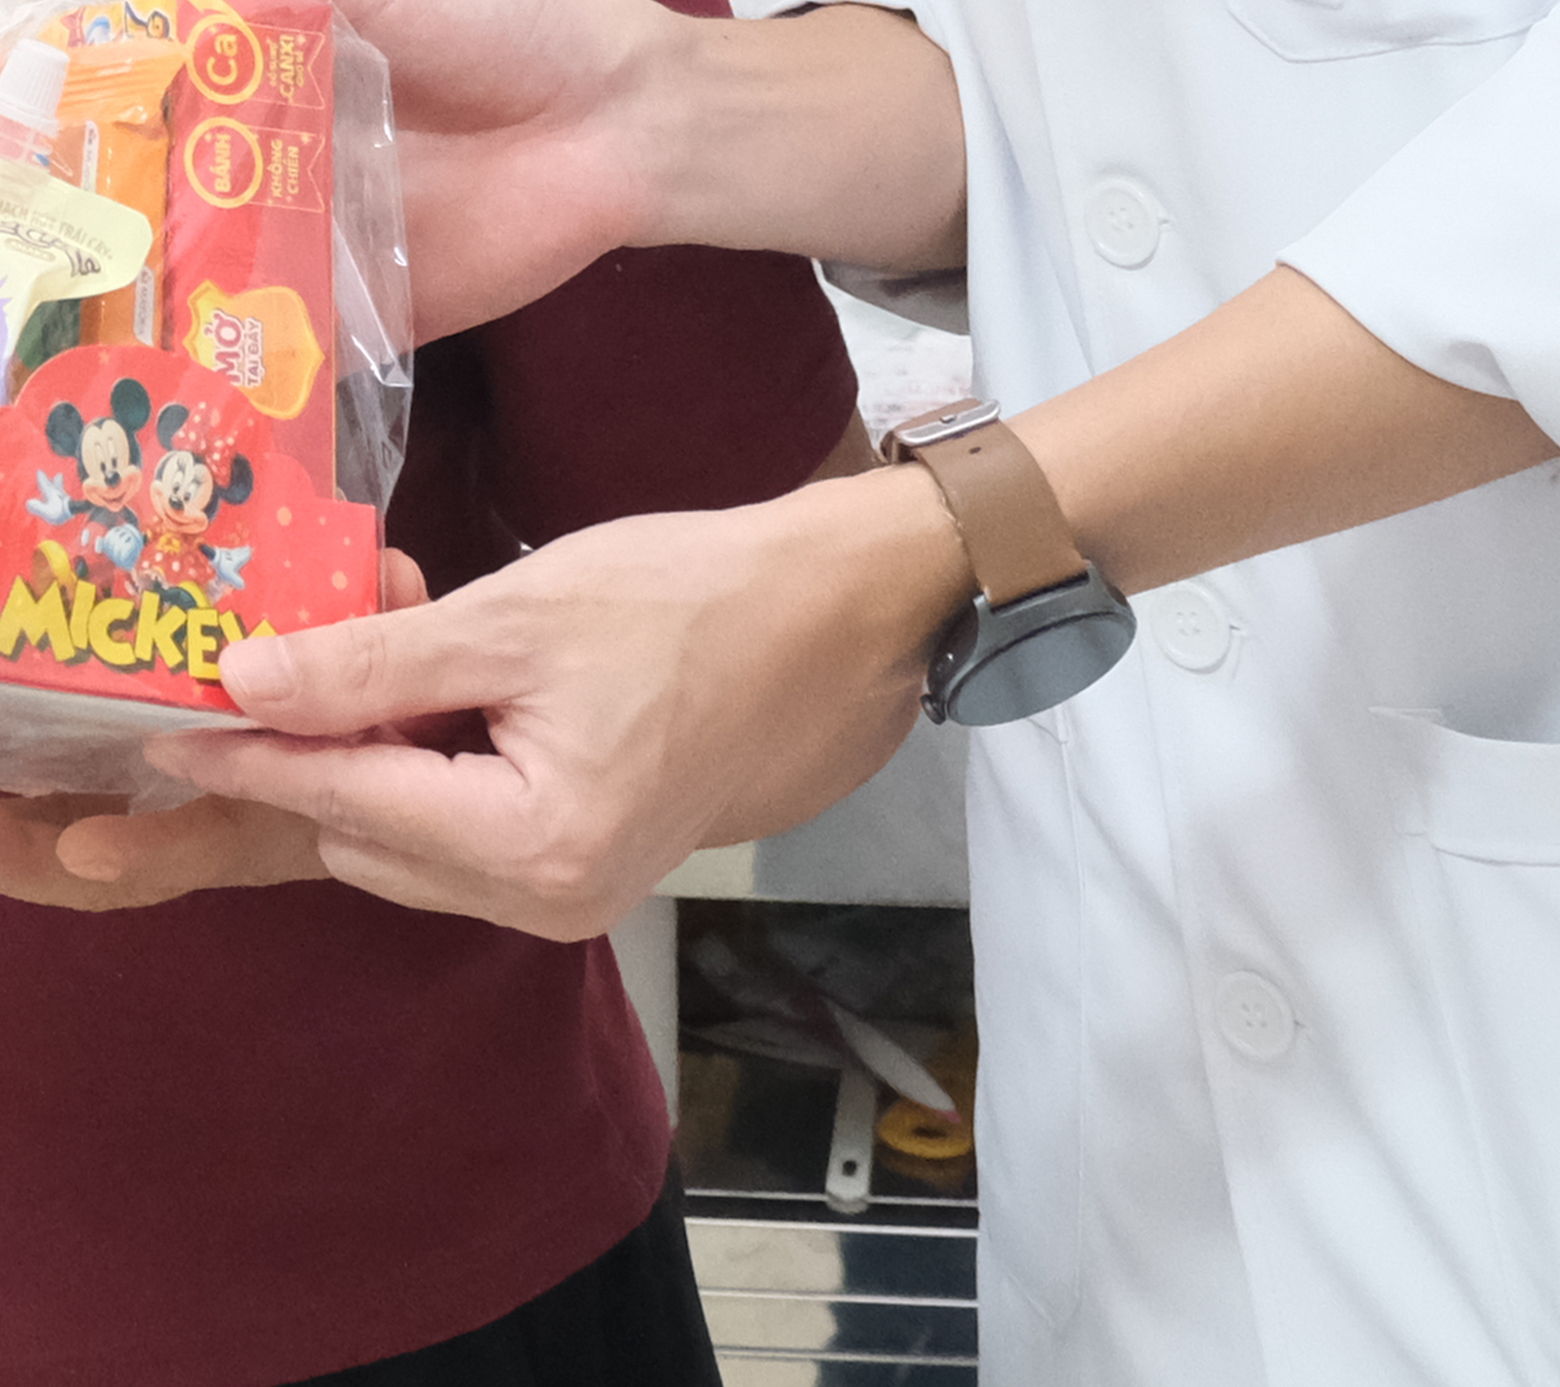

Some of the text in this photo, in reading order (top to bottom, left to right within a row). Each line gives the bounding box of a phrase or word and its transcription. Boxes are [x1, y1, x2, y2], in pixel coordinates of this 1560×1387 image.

[206, 33, 239, 86] Ca
[279, 34, 295, 100] CANXI
[209, 133, 232, 194] BÁNH
[267, 138, 283, 198] KHÔNG
